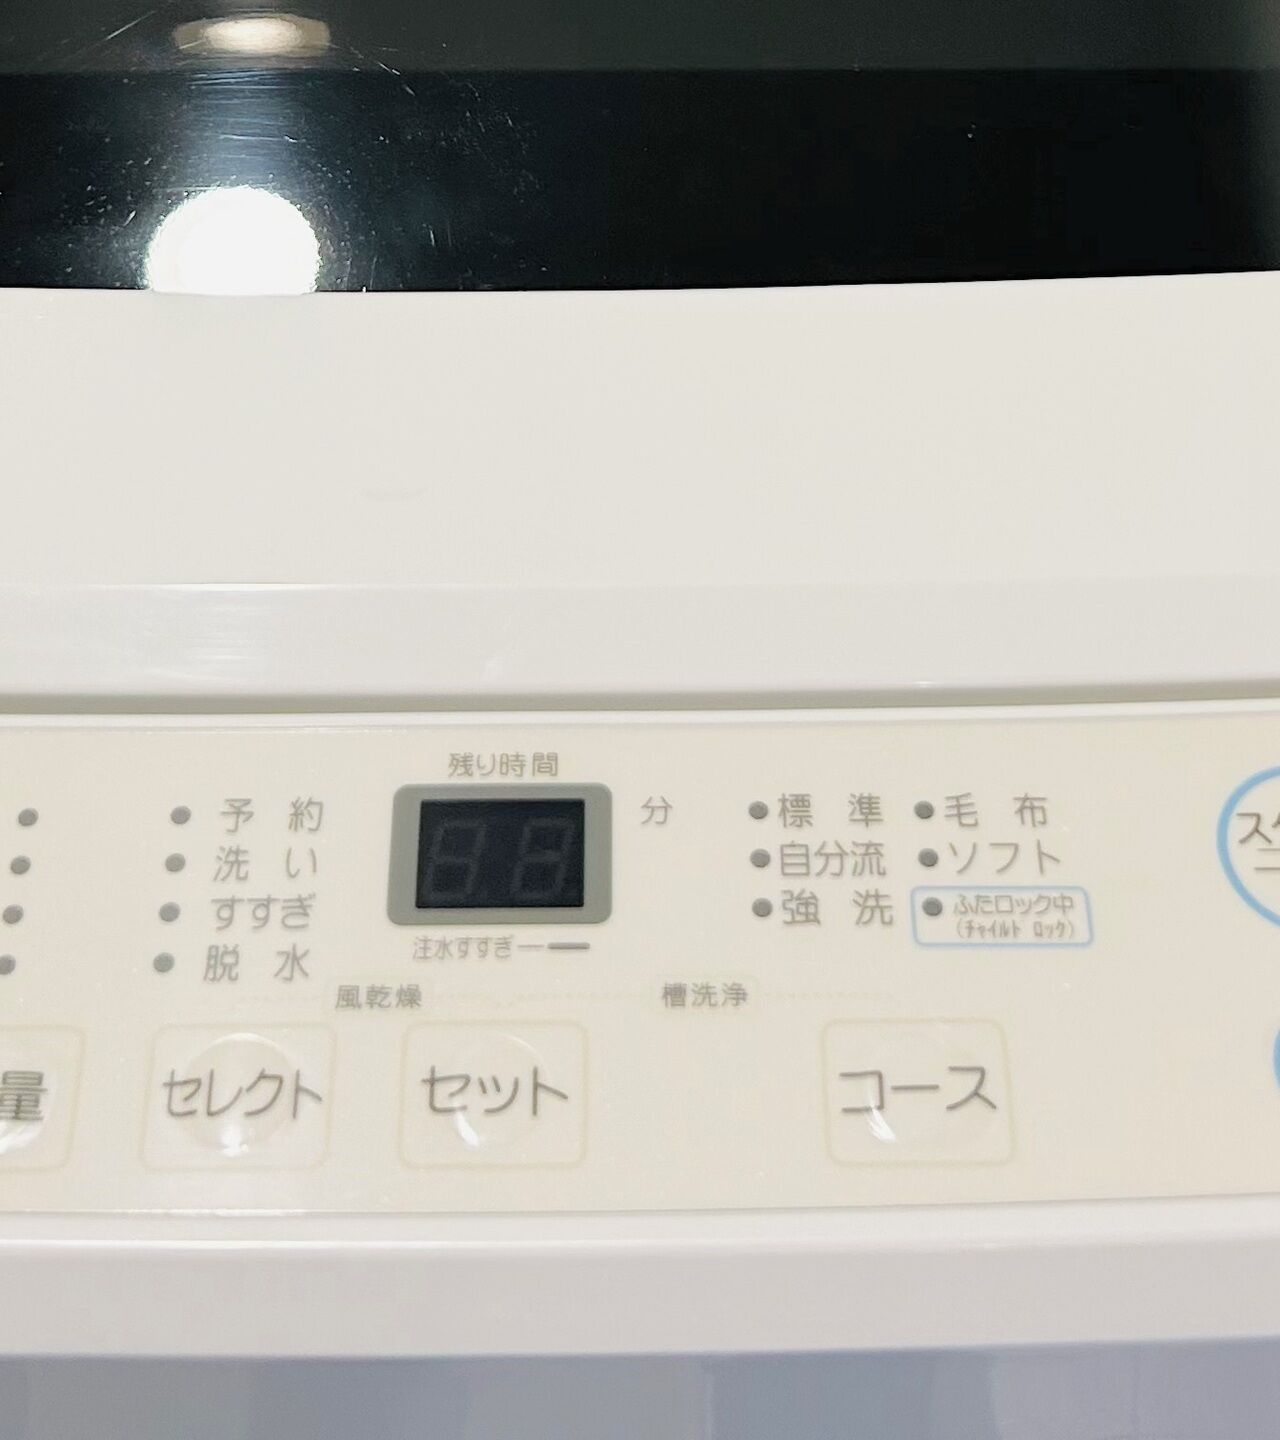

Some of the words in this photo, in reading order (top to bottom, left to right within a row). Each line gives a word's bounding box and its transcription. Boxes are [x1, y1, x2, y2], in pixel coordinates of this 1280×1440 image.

[447, 751, 559, 779] 残り時間
[220, 796, 324, 834] 予約
[640, 795, 674, 826] 分
[777, 792, 884, 830] 標準
[943, 792, 1048, 829] 毛布
[212, 844, 318, 883] 洗い
[779, 839, 888, 879] 自分流
[945, 839, 1061, 871] ソフト
[210, 892, 317, 932] すすぎ
[781, 888, 894, 927] 強洗
[953, 893, 1074, 916] ふたロック中
[202, 943, 310, 983] 脱水
[411, 934, 514, 961] 注水すすぎ
[334, 983, 423, 1010] 風乾燥
[661, 982, 749, 1009] 槽洗浄
[162, 1067, 323, 1122] セレクト
[420, 1064, 570, 1118] セット
[837, 1065, 998, 1115] コース
